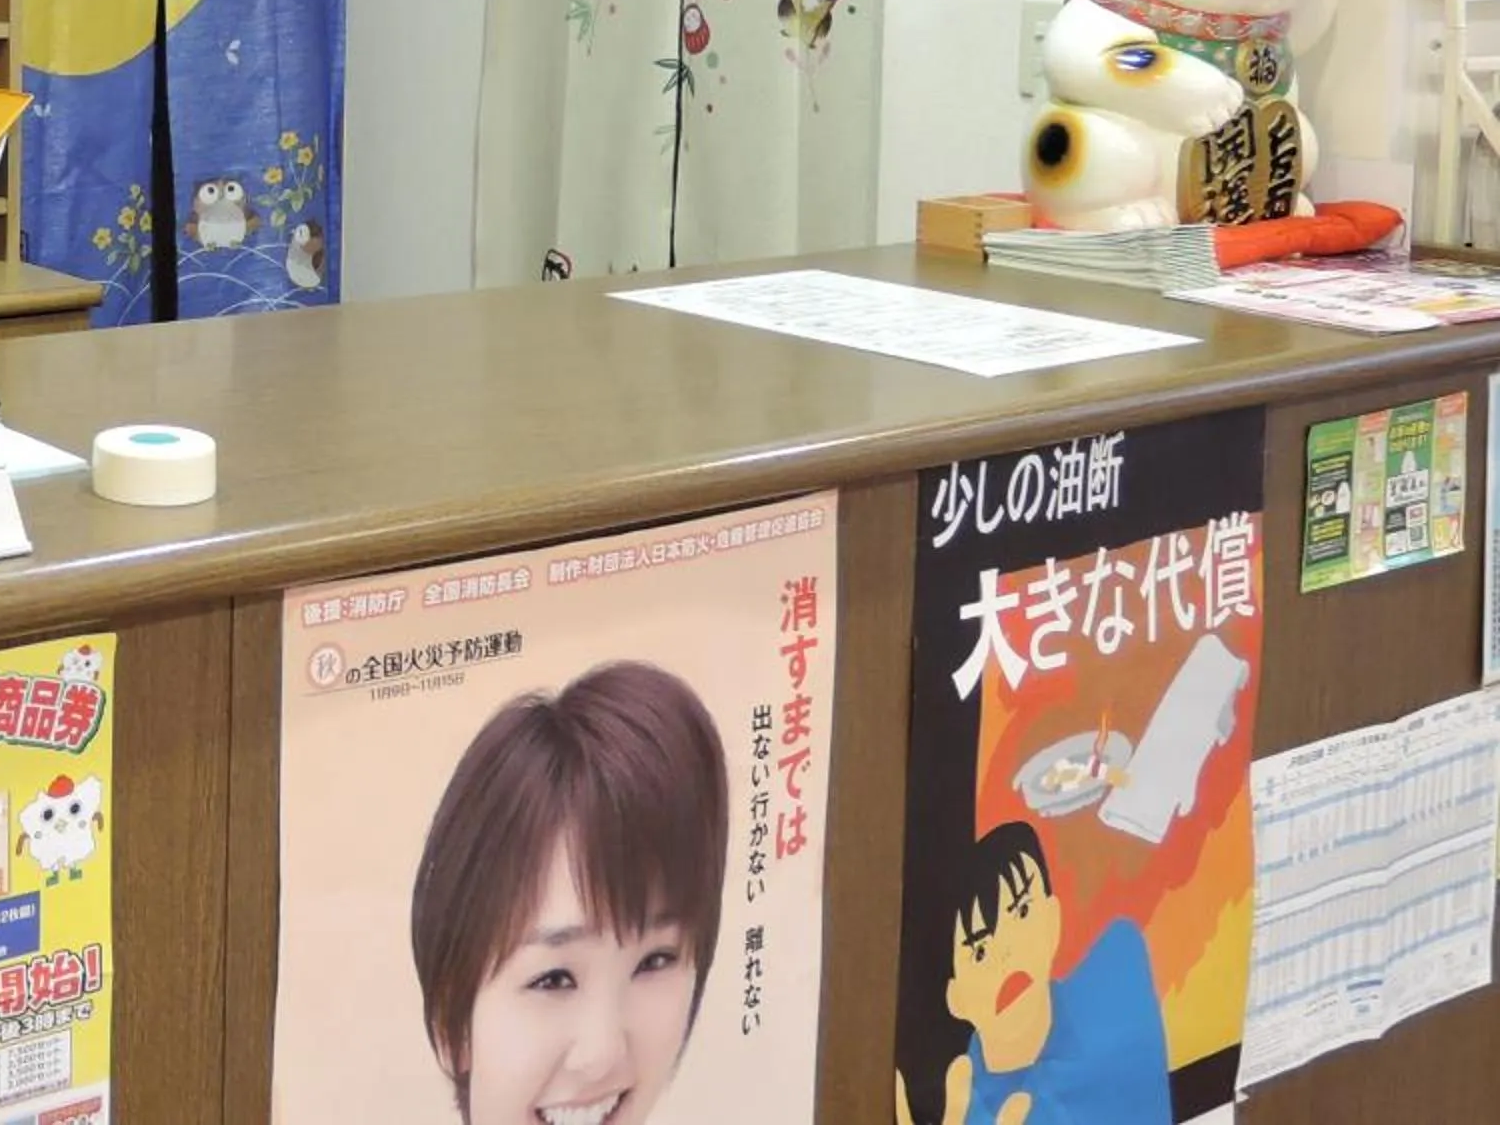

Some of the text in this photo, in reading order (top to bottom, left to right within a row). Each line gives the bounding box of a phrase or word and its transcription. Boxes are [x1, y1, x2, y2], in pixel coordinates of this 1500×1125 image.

[931, 430, 1125, 549] 少しの油断
[313, 628, 523, 686] 秋の全国火災予防運動
[951, 510, 1255, 701] 大きな代償
[774, 575, 818, 861] 消すまでは
